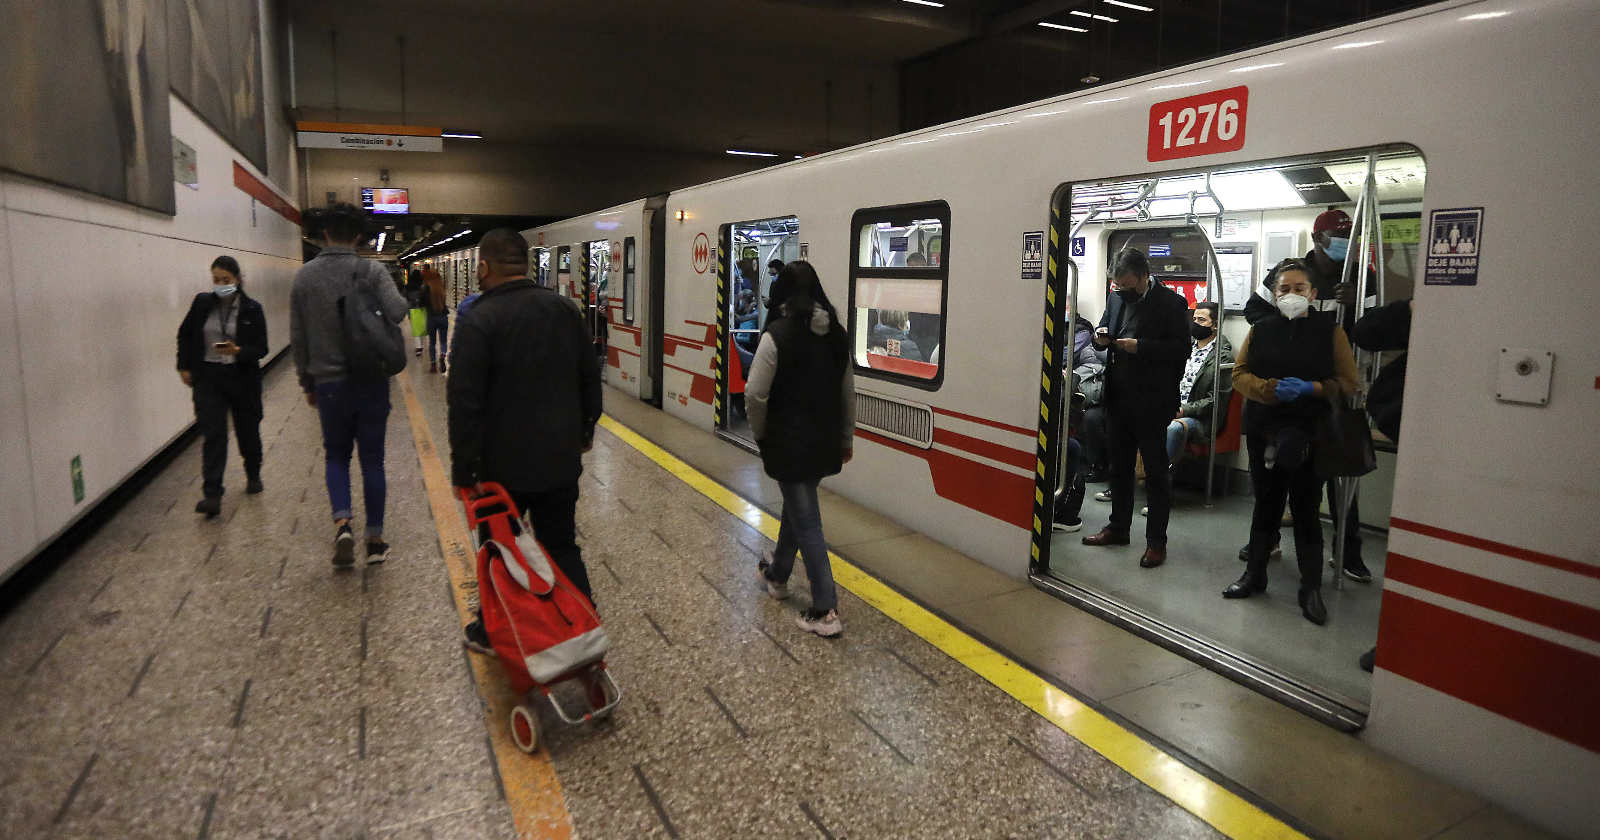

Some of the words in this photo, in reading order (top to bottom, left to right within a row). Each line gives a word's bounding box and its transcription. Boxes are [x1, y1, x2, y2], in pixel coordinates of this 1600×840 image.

[1159, 99, 1239, 149] 1276
[340, 136, 384, 145] Combinación
[1428, 258, 1448, 267] DEJE
[1449, 258, 1476, 267] BAJAR
